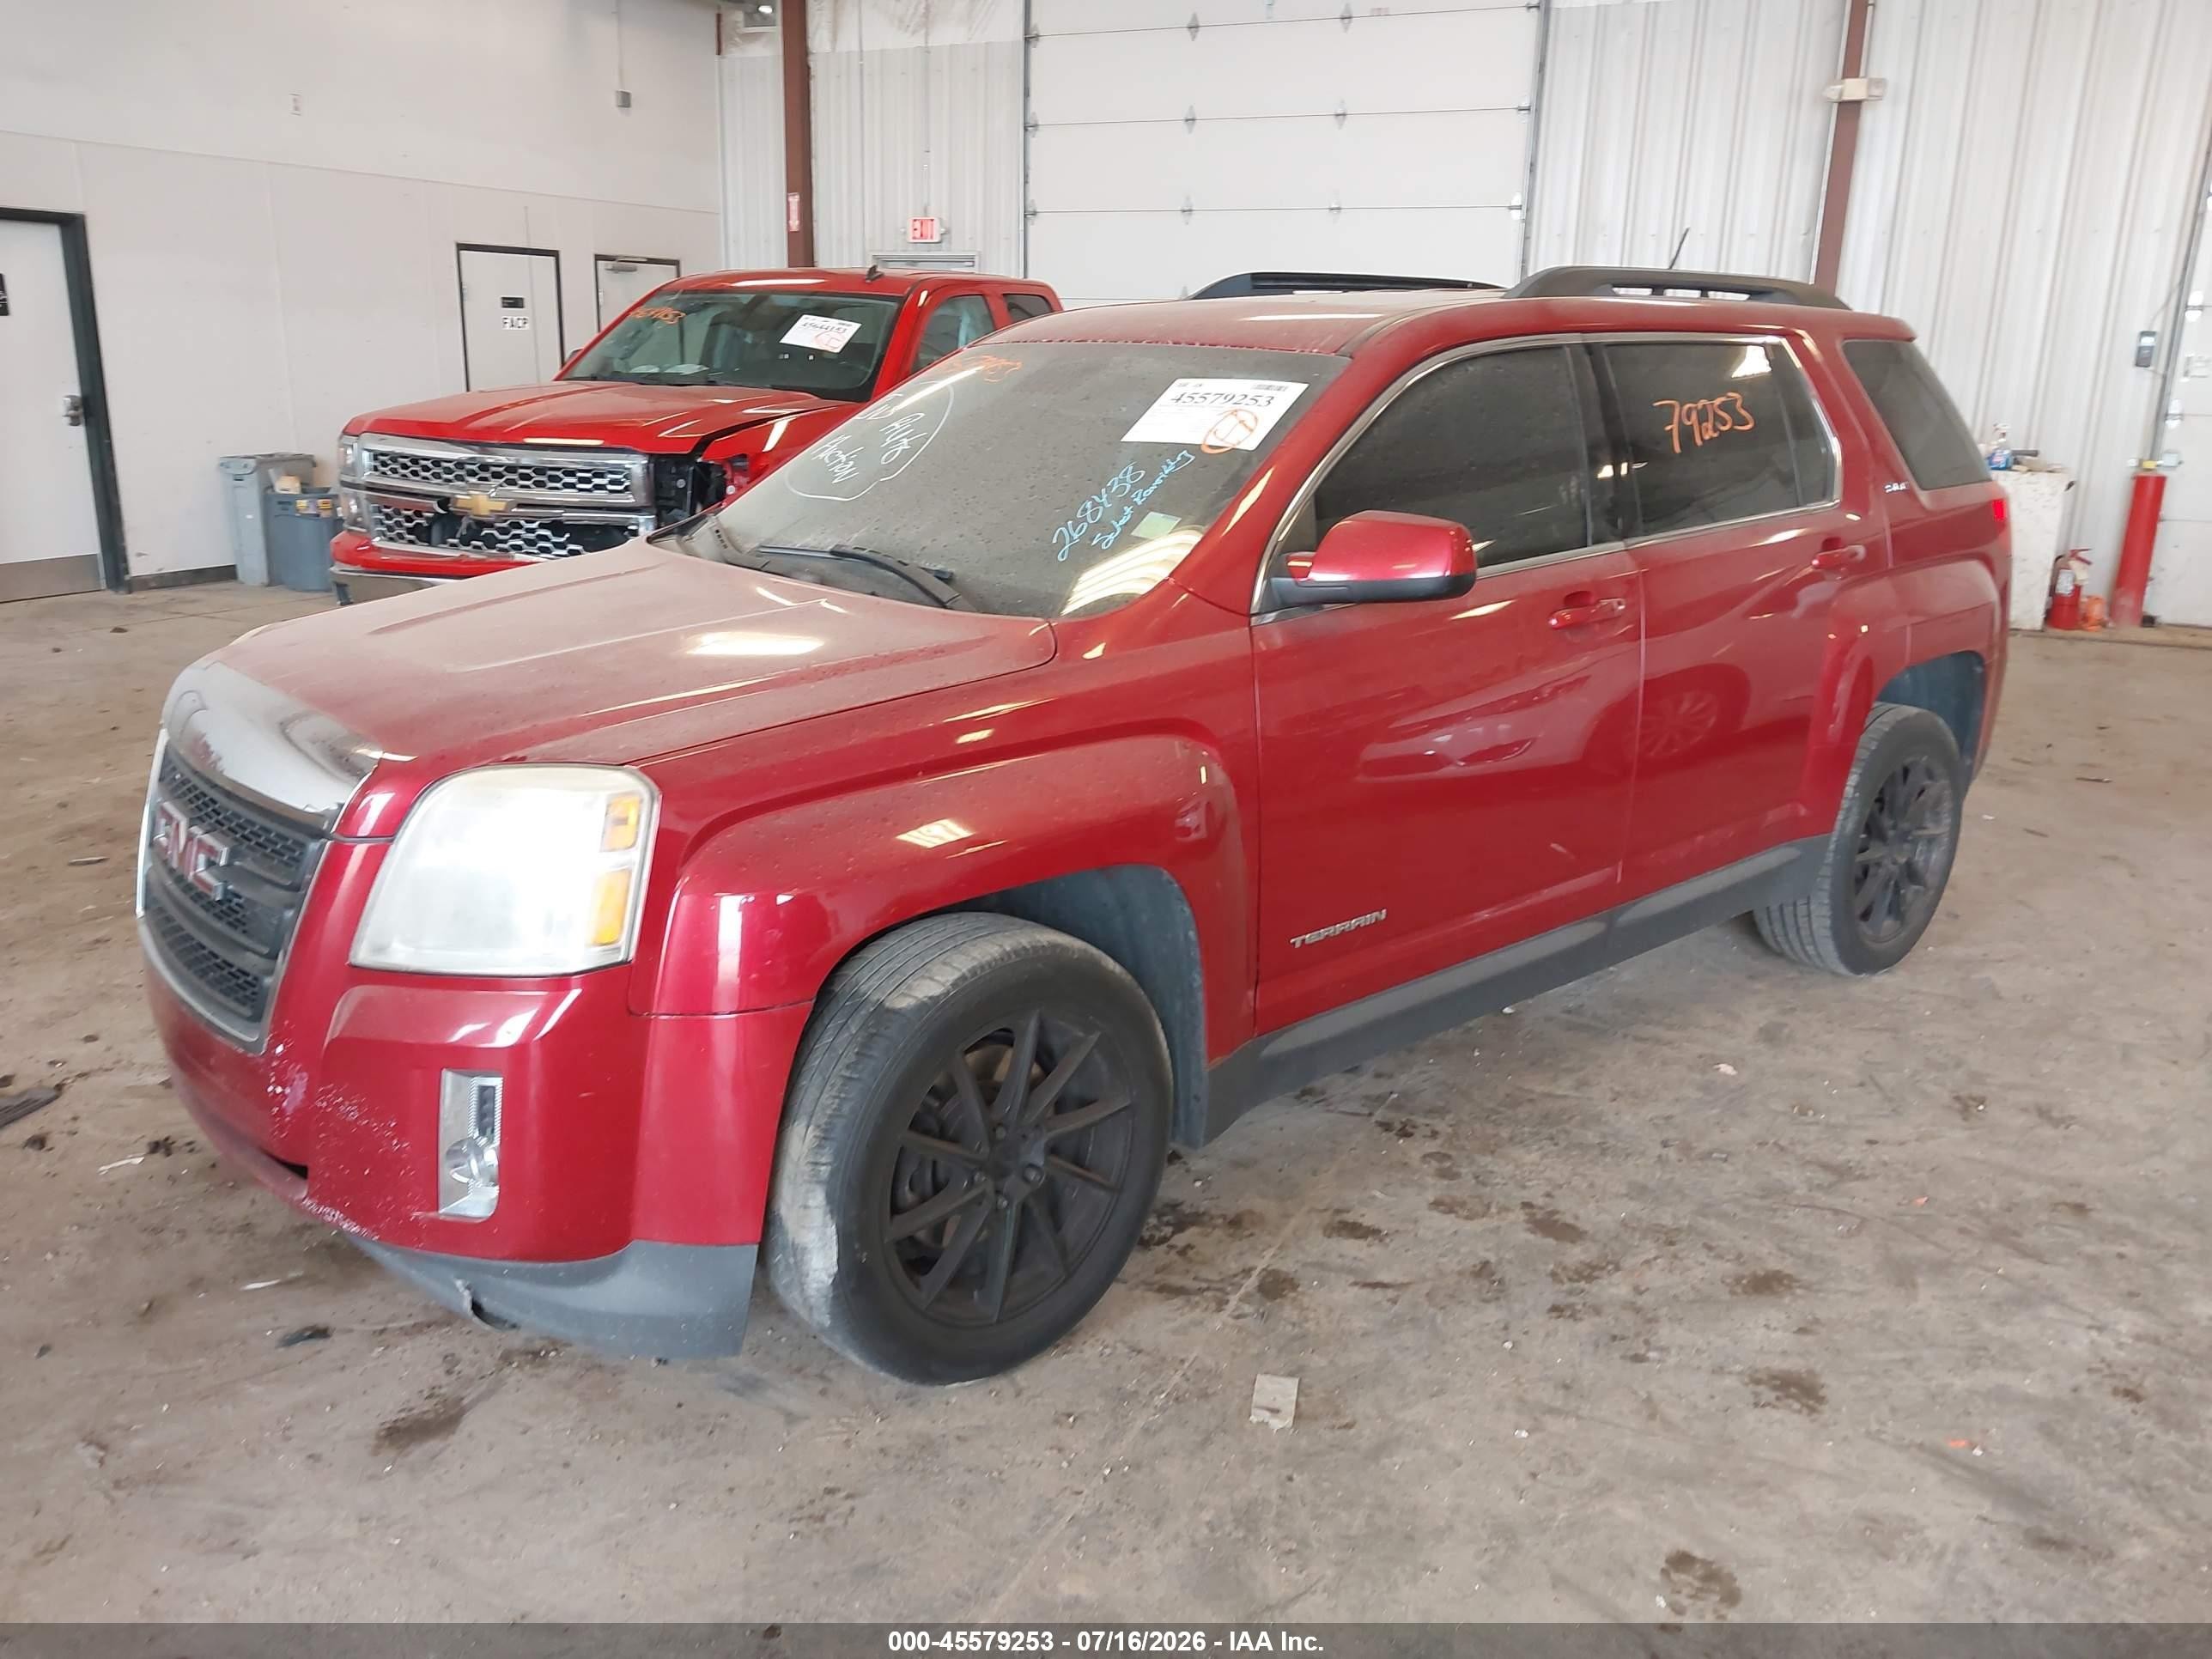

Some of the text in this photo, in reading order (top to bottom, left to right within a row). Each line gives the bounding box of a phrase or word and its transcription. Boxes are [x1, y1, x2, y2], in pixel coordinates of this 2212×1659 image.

[1170, 392, 1275, 407] 45579253
[1652, 392, 1755, 454] 79253
[1052, 461, 1146, 562] 268438
[153, 800, 229, 902] GMC
[1289, 908, 1387, 949] TERRAIN
